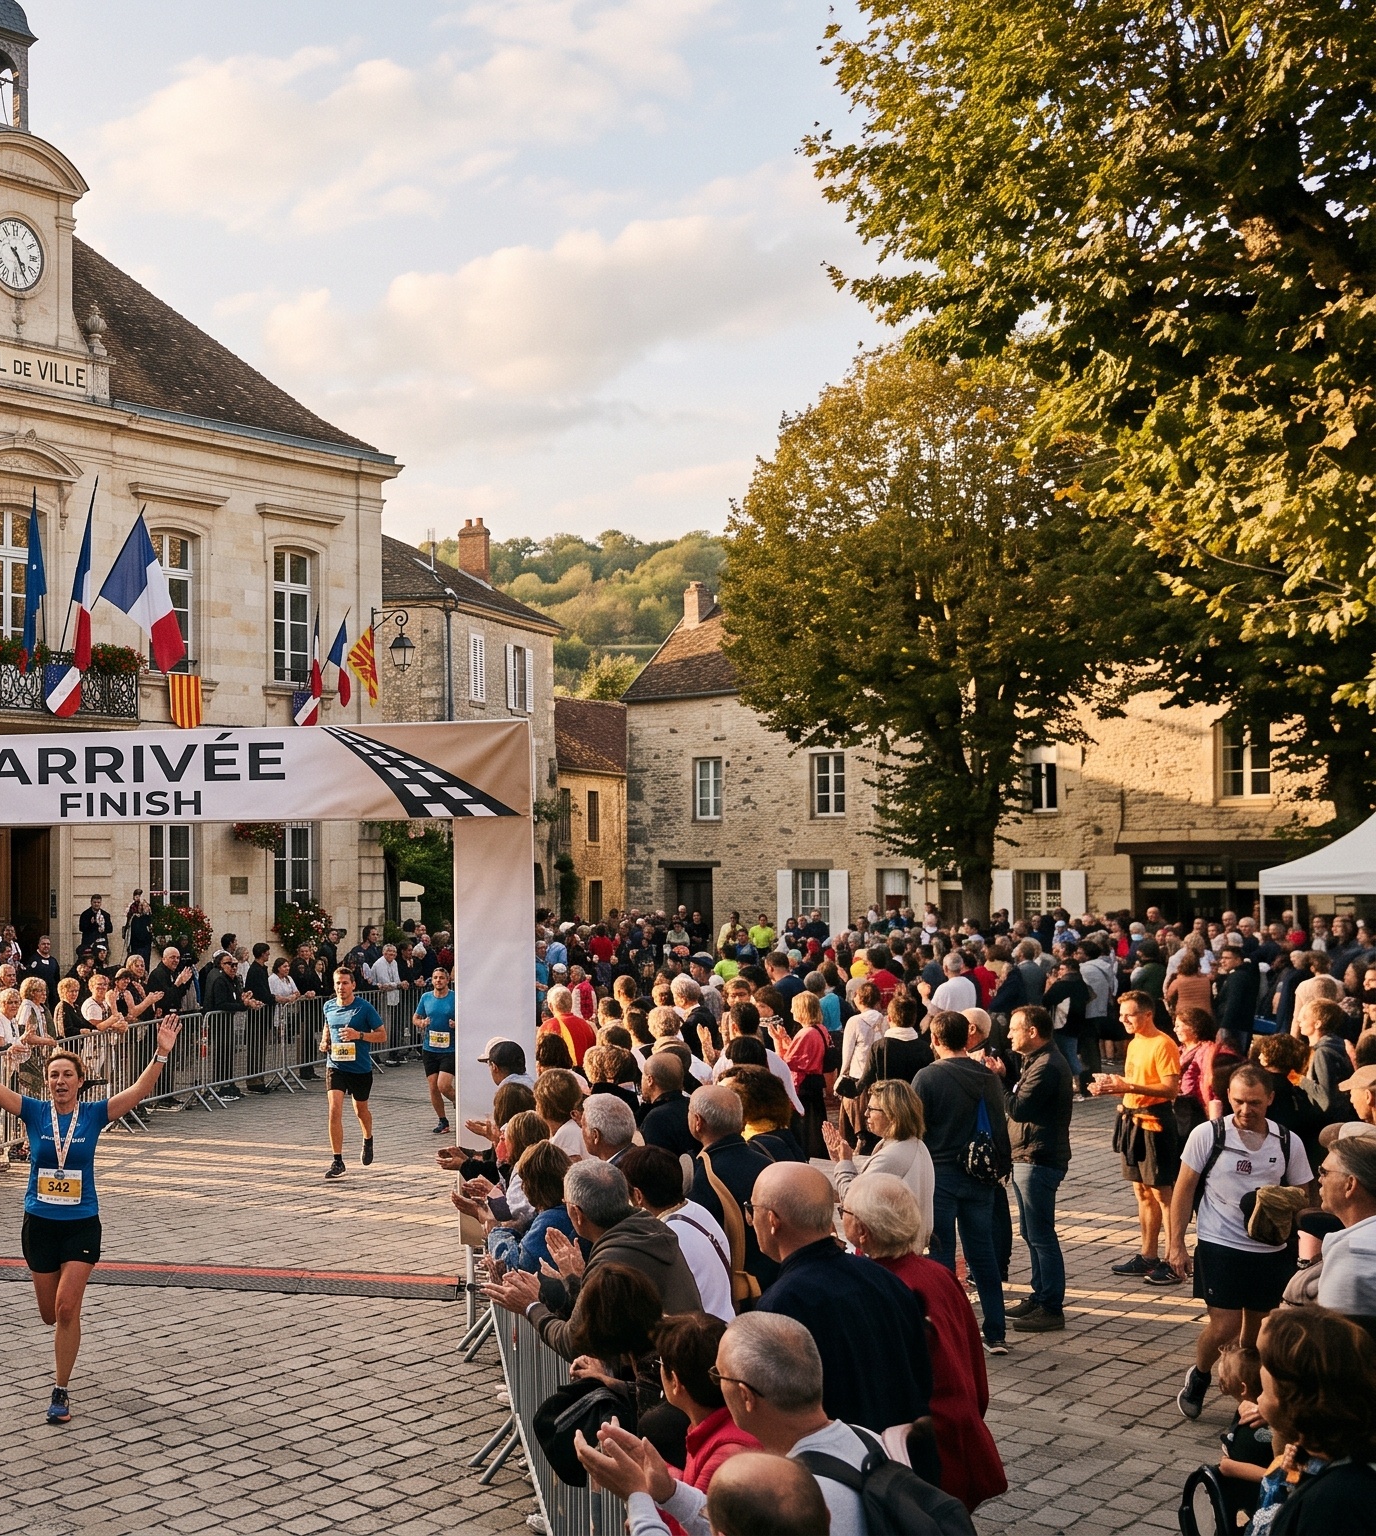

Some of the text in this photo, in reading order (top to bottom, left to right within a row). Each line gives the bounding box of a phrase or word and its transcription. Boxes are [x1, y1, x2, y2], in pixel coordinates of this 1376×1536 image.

[13, 359, 32, 378] DE
[37, 359, 86, 389] VILLE
[59, 790, 202, 818] FINISH
[47, 1181, 70, 1193] 342
